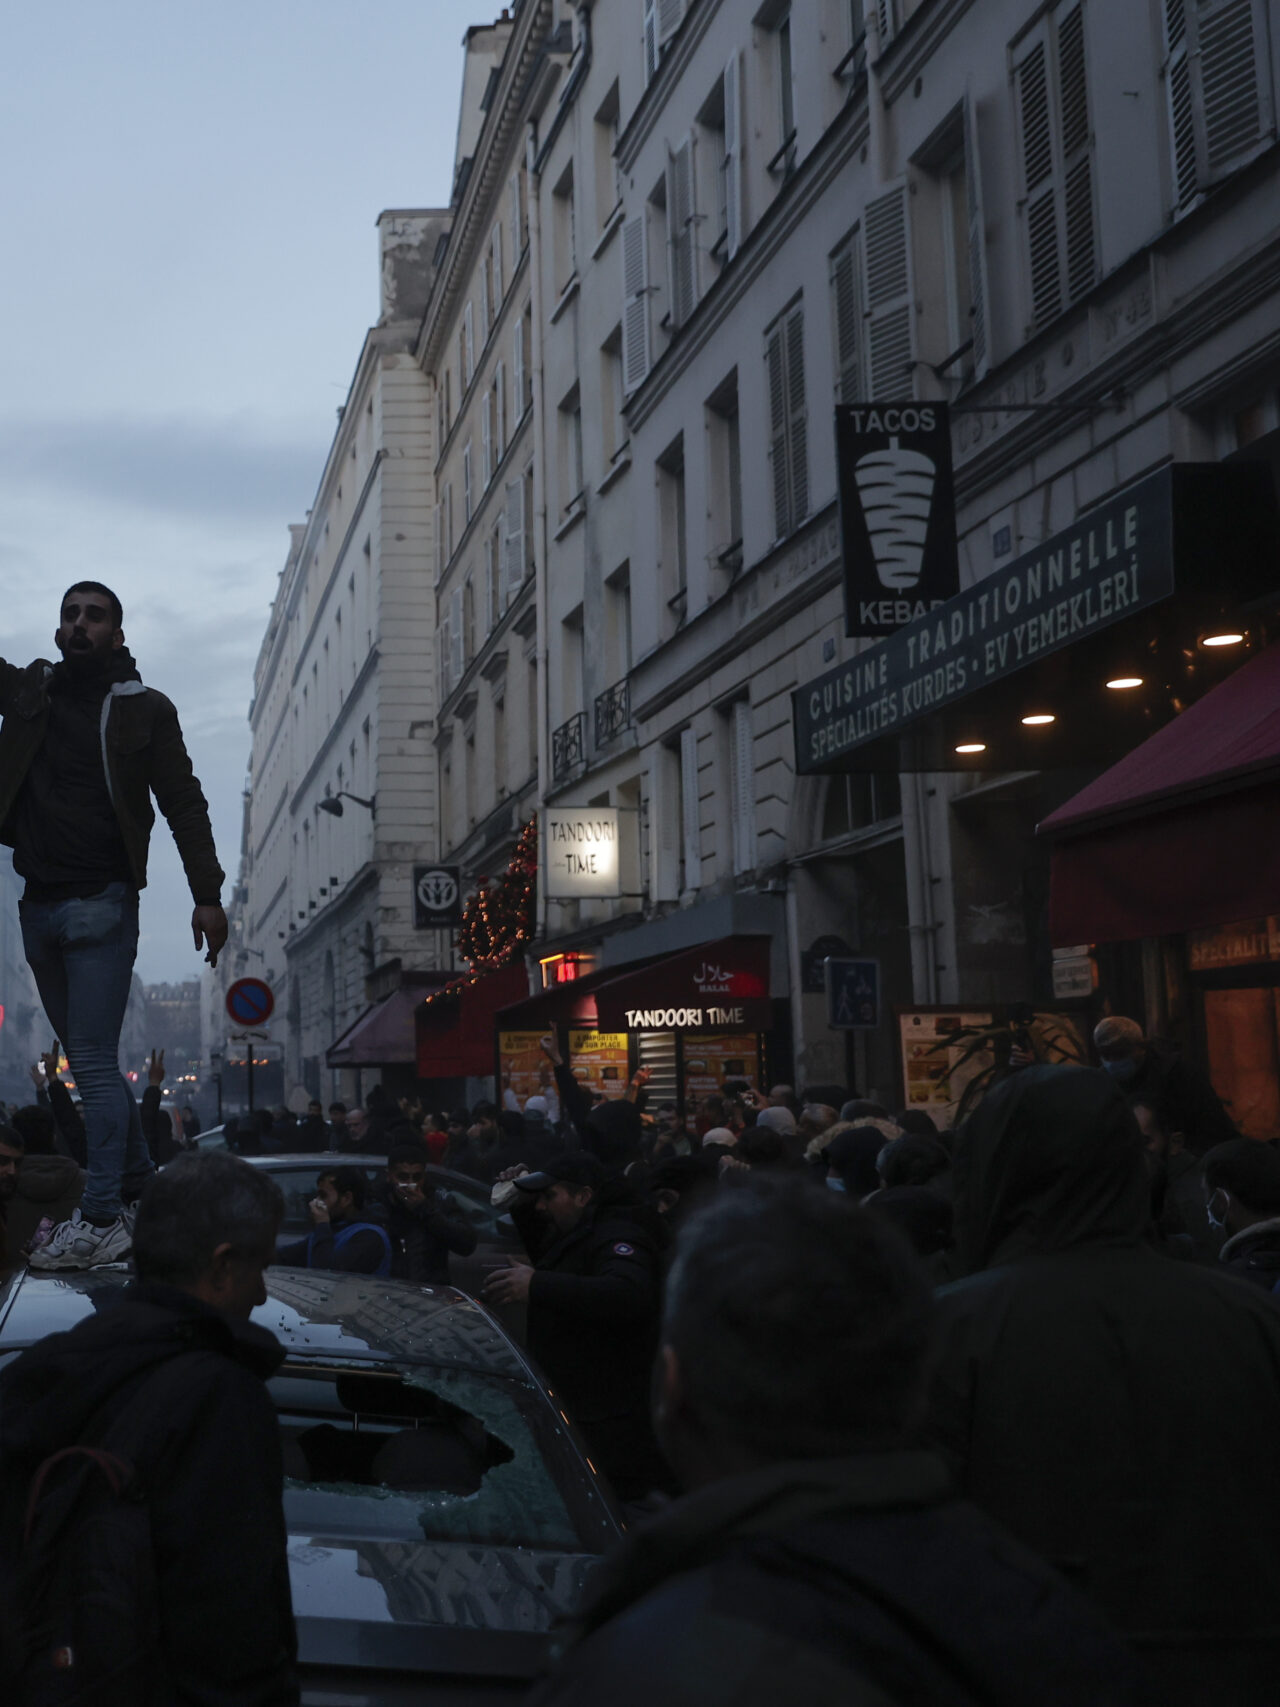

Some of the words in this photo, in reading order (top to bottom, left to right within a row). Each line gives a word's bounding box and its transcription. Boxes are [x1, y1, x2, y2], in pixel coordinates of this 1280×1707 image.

[849, 408, 937, 433] TACOS
[809, 653, 888, 720] CUISINE
[907, 505, 1137, 669] TRADITIONNELLE
[811, 688, 898, 760] SPÉCIALITÉS
[902, 656, 967, 717] KURDES
[985, 632, 1009, 676] EV
[1013, 554, 1140, 660] YEMEKLERİ
[550, 822, 615, 842] TANDOORI
[565, 854, 597, 874] TIME
[693, 962, 734, 984] حلال
[699, 984, 730, 993] HALAL
[624, 1008, 703, 1028] TANDOORI
[706, 1007, 745, 1025] TIME
